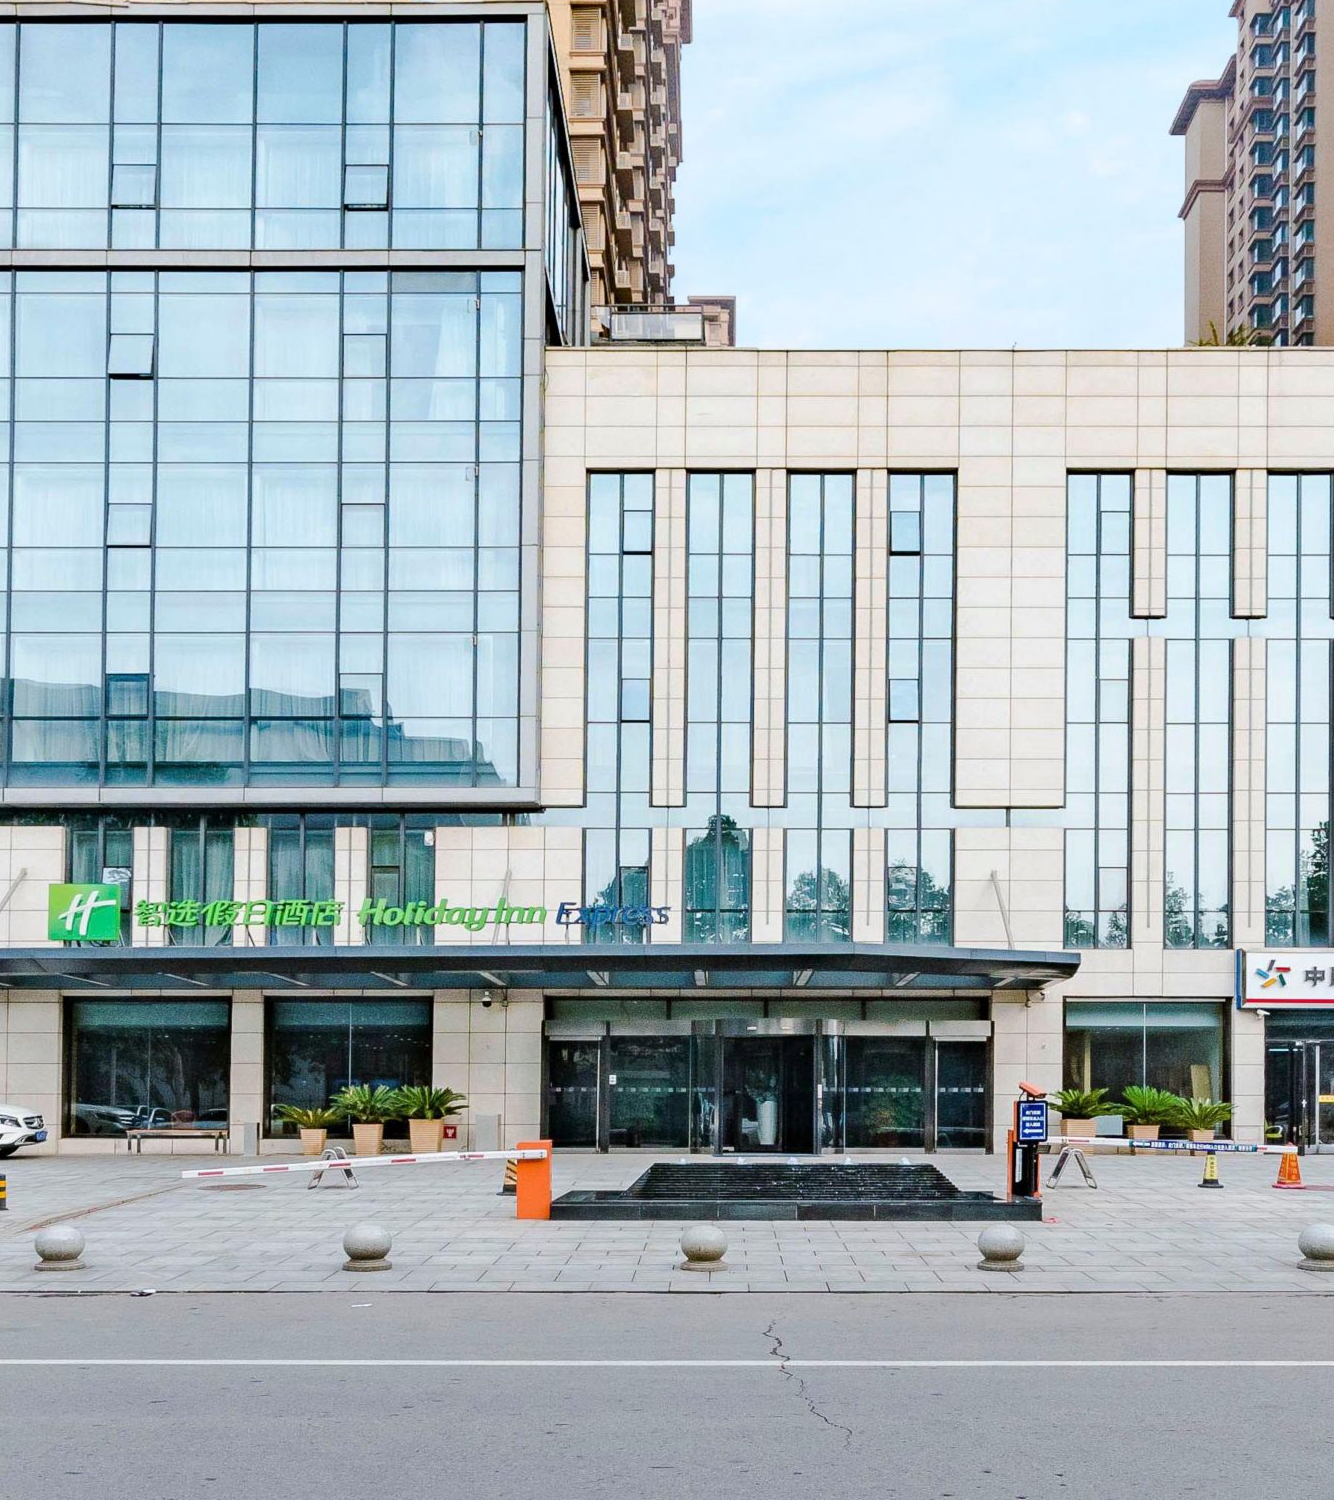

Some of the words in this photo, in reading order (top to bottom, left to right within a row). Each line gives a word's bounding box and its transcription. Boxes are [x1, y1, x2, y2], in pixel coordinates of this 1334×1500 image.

[134, 899, 345, 927] 智选假日酒店
[356, 898, 491, 932] Holiday
[493, 897, 548, 925] Inn
[555, 901, 671, 927] Express
